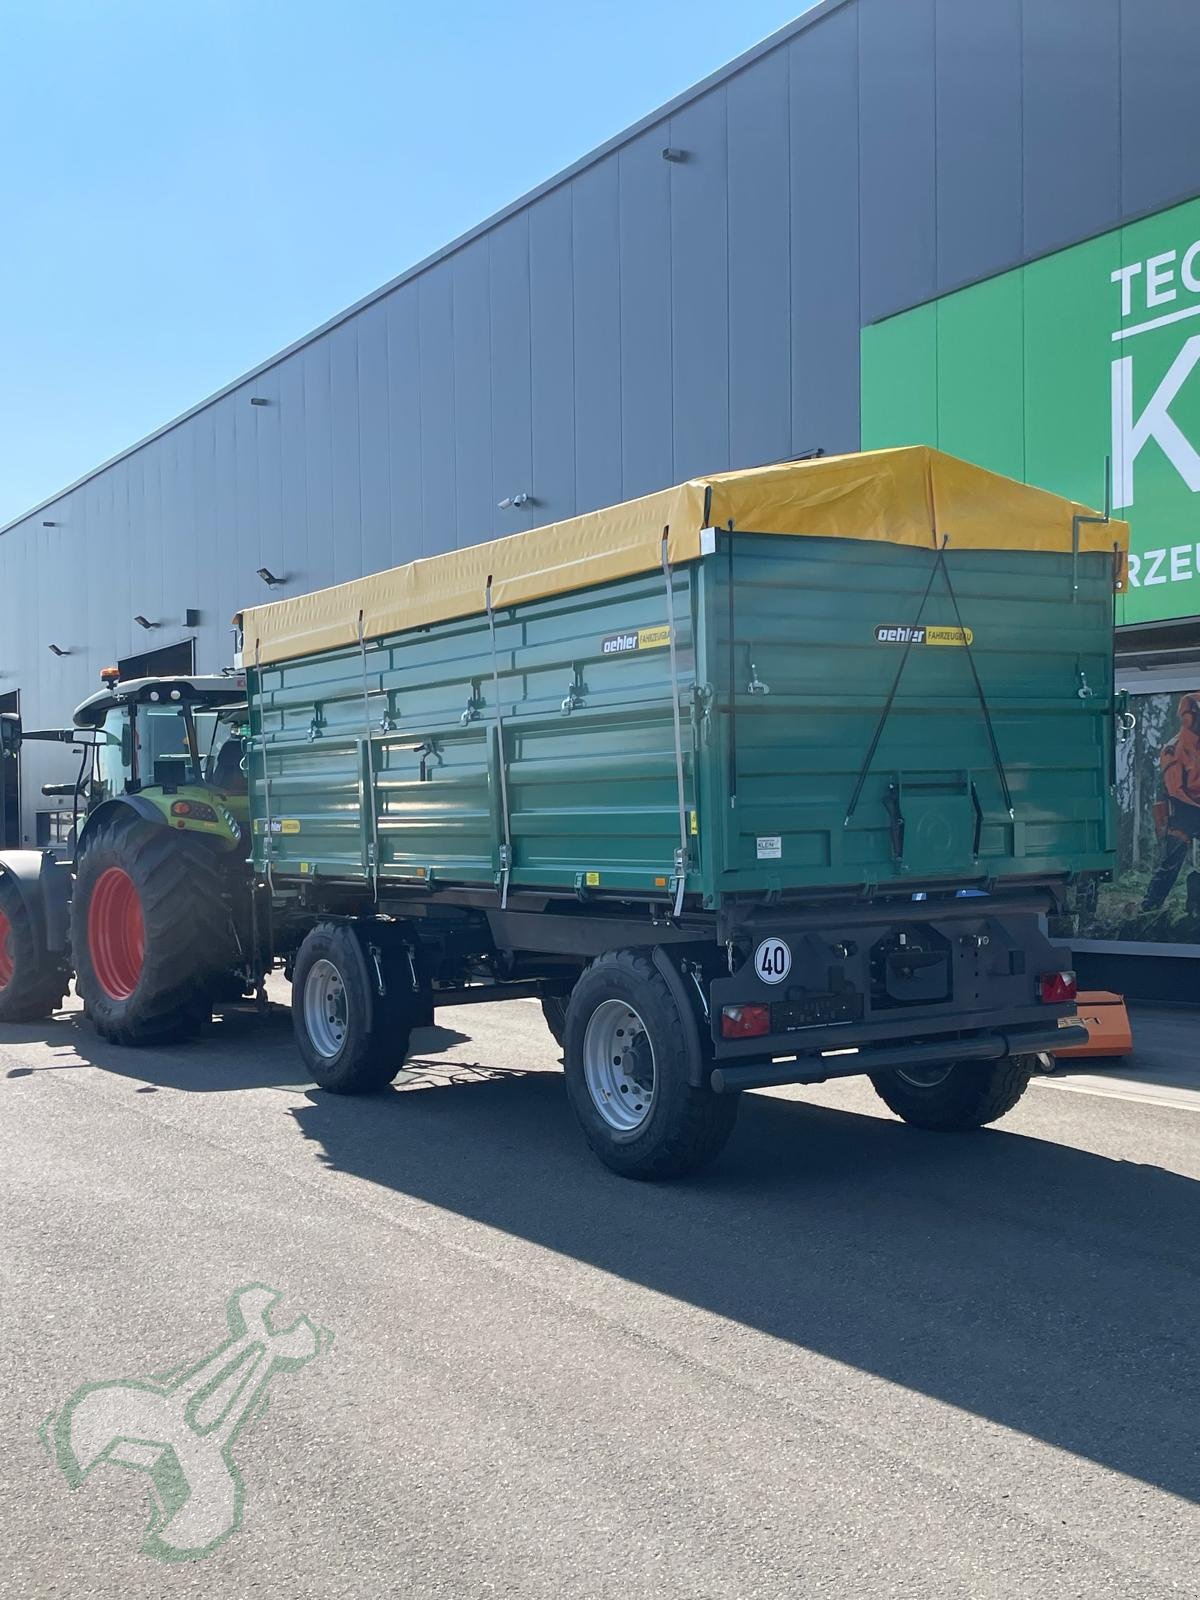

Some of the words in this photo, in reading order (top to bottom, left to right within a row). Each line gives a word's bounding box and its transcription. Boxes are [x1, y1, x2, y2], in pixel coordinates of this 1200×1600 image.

[1111, 333, 1200, 510] K
[1128, 543, 1200, 587] RZE
[603, 635, 638, 653] oehler
[877, 627, 925, 643] oehler
[762, 946, 785, 975] 40
